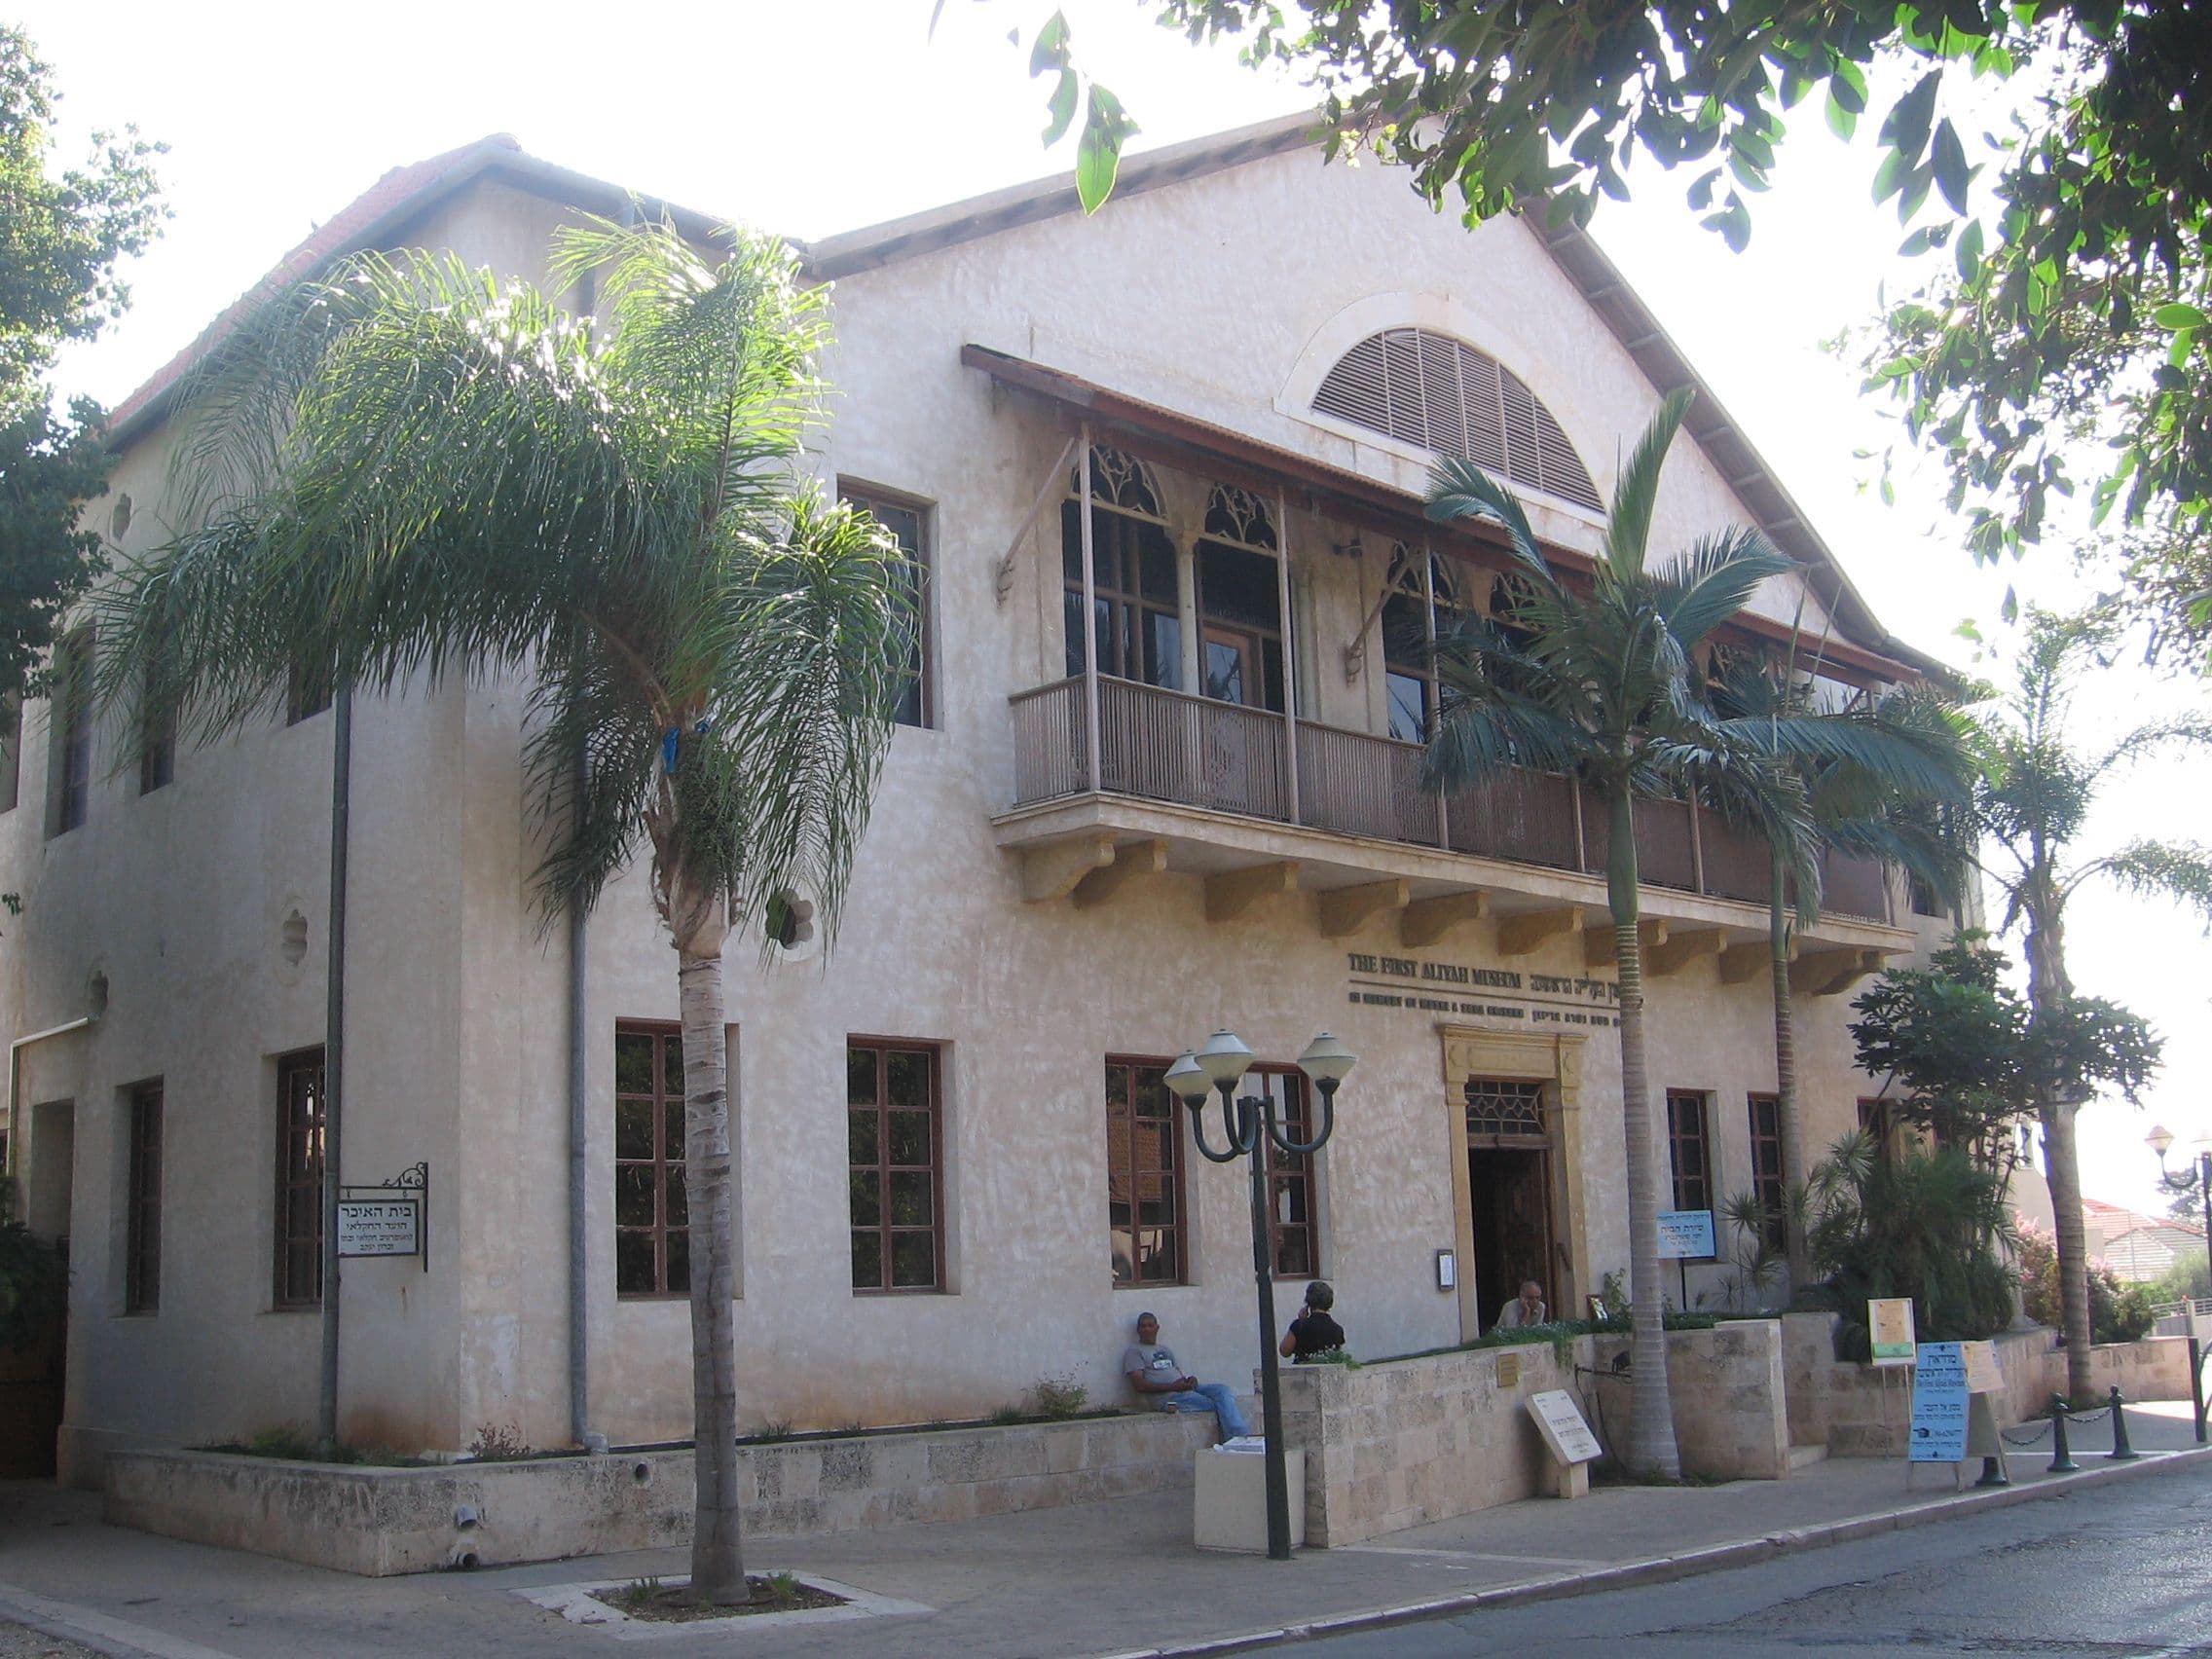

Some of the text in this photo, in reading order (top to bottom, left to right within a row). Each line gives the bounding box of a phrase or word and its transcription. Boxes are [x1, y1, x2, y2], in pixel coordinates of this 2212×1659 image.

[1348, 953, 1521, 989] THE FIRST ALIYAH MUSEUM
[1348, 992, 1360, 1003] IN
[1363, 993, 1402, 1007] MEMORY
[1405, 997, 1417, 1008] OF
[1452, 1002, 1458, 1012] &
[342, 1207, 412, 1218] בית האיכר
[346, 1220, 381, 1232] החקלאי
